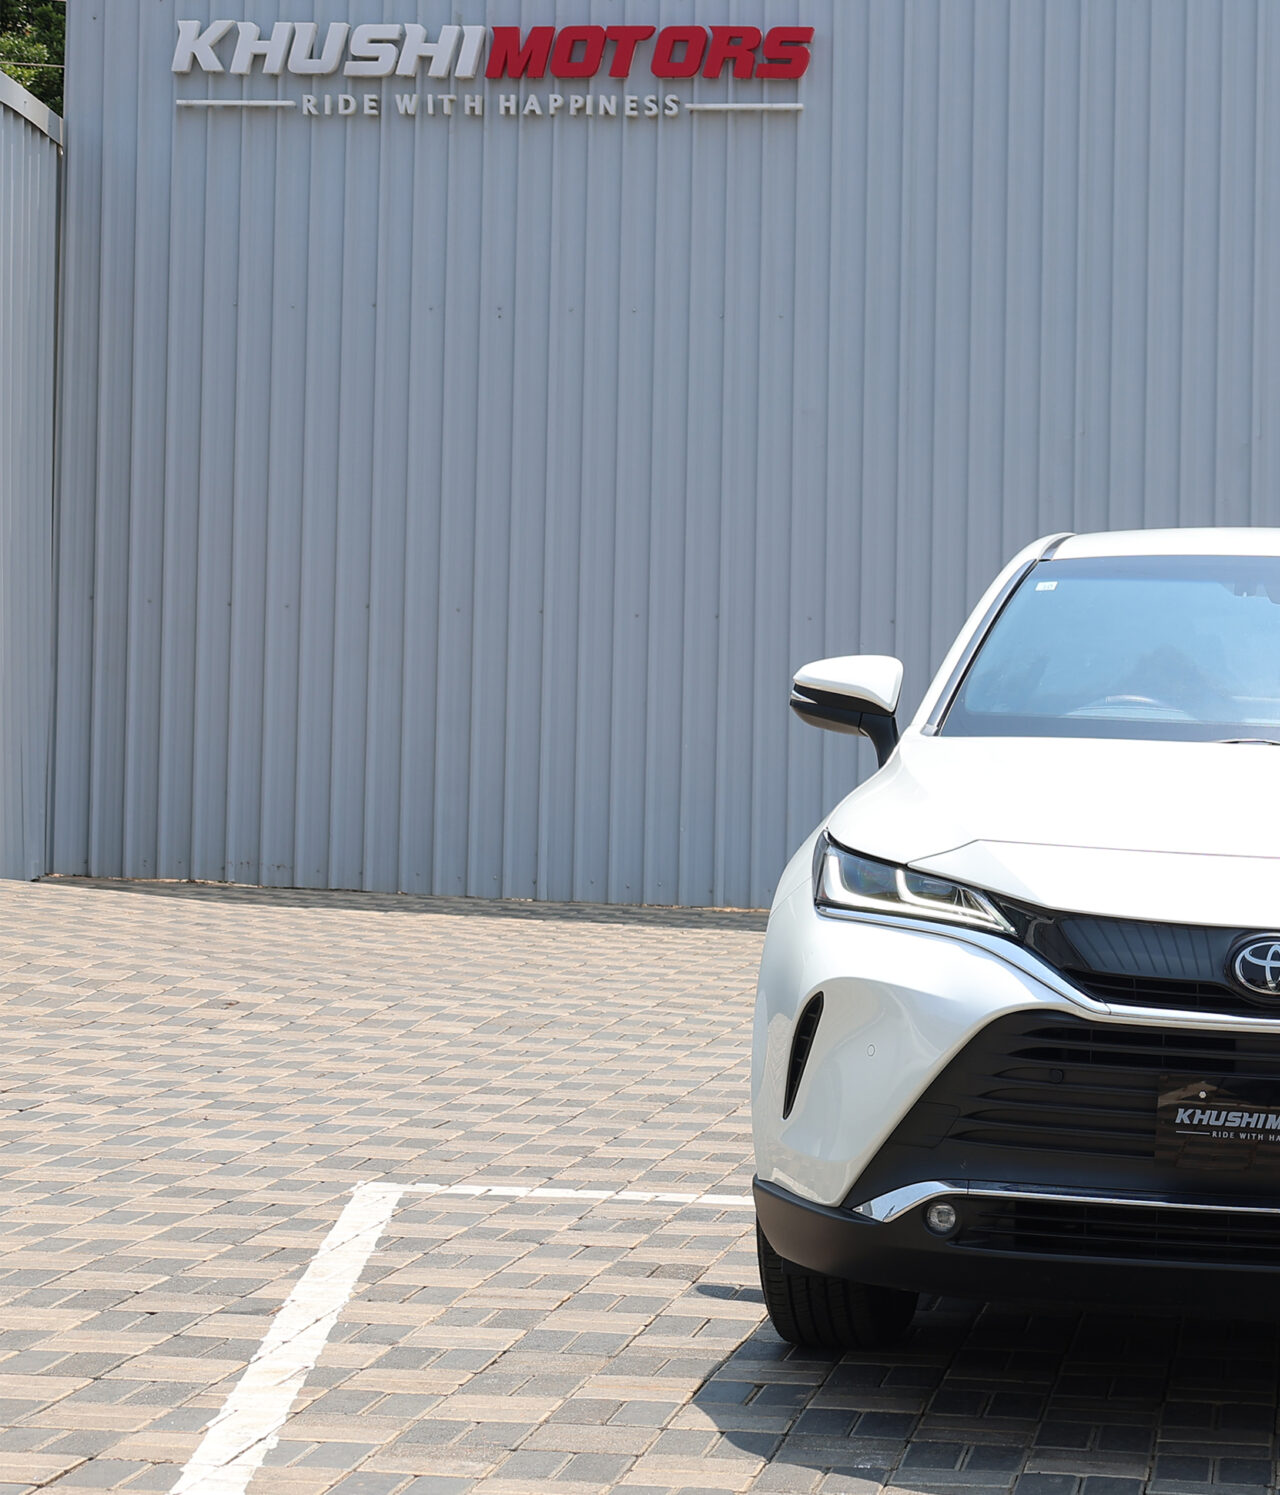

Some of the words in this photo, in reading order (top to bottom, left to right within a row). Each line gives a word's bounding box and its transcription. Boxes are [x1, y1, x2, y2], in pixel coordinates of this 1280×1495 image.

[302, 94, 379, 115] RIDE
[395, 94, 483, 116] WITH
[499, 94, 680, 117] HAPPINESS
[1212, 1130, 1235, 1139] RIDE
[1239, 1132, 1264, 1141] WITH
